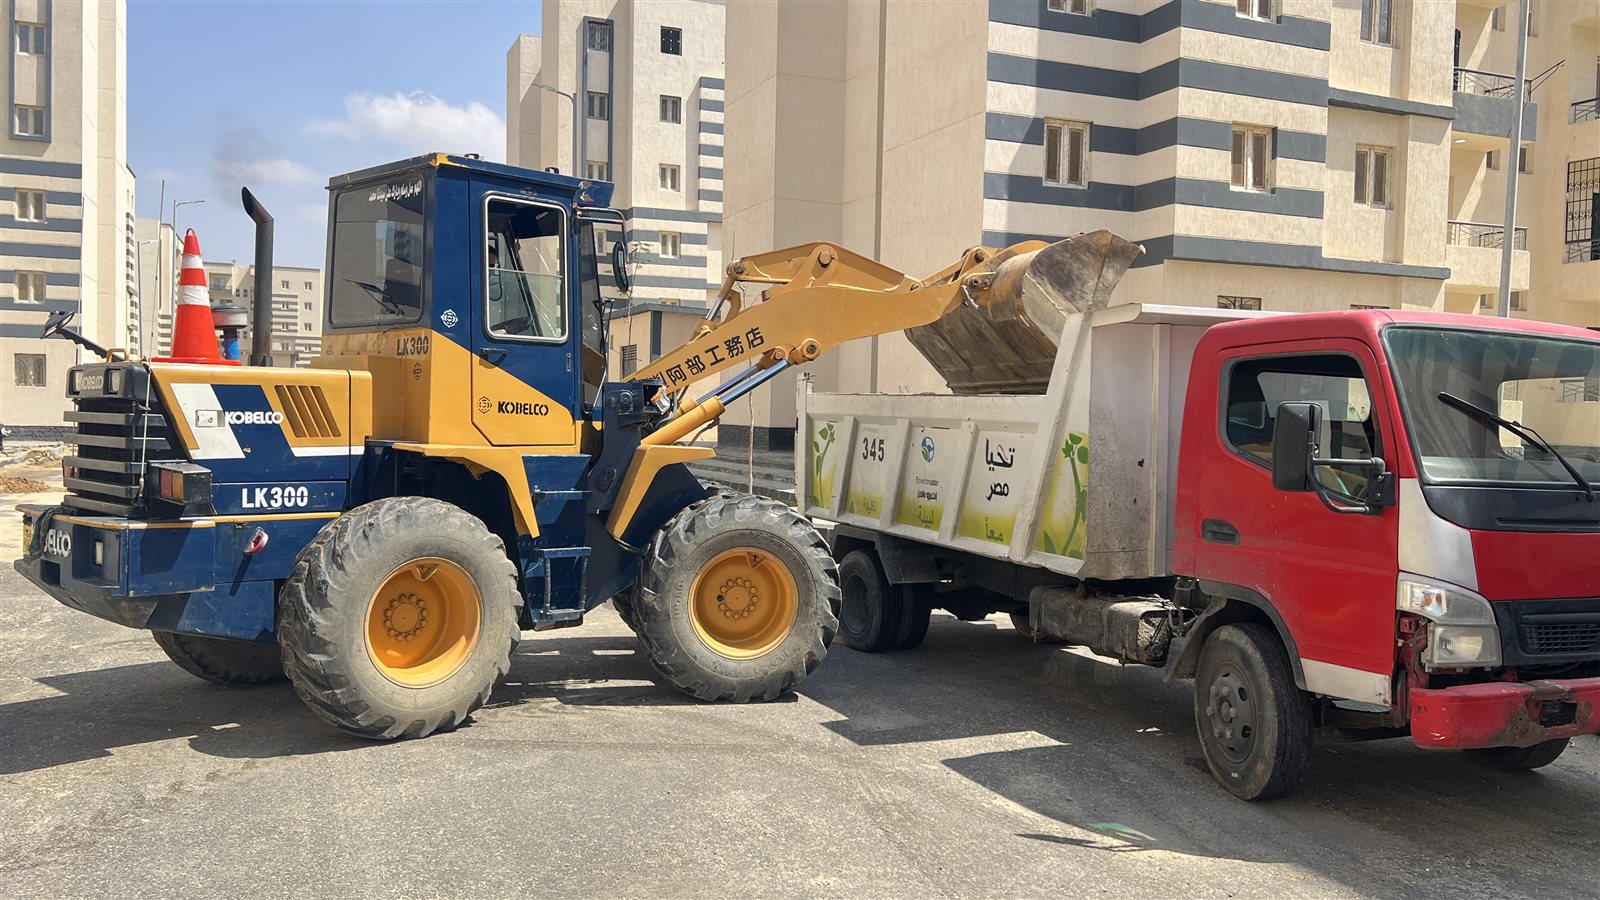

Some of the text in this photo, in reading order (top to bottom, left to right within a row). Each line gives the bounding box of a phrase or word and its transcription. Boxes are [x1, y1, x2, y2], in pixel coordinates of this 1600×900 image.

[397, 336, 429, 356] LK300
[225, 411, 284, 424] KOBELCO
[497, 401, 549, 417] KOBELCO
[863, 437, 885, 462] 345
[986, 438, 1015, 472] تحيا
[242, 487, 309, 508] LK300
[985, 482, 1009, 502] مصر
